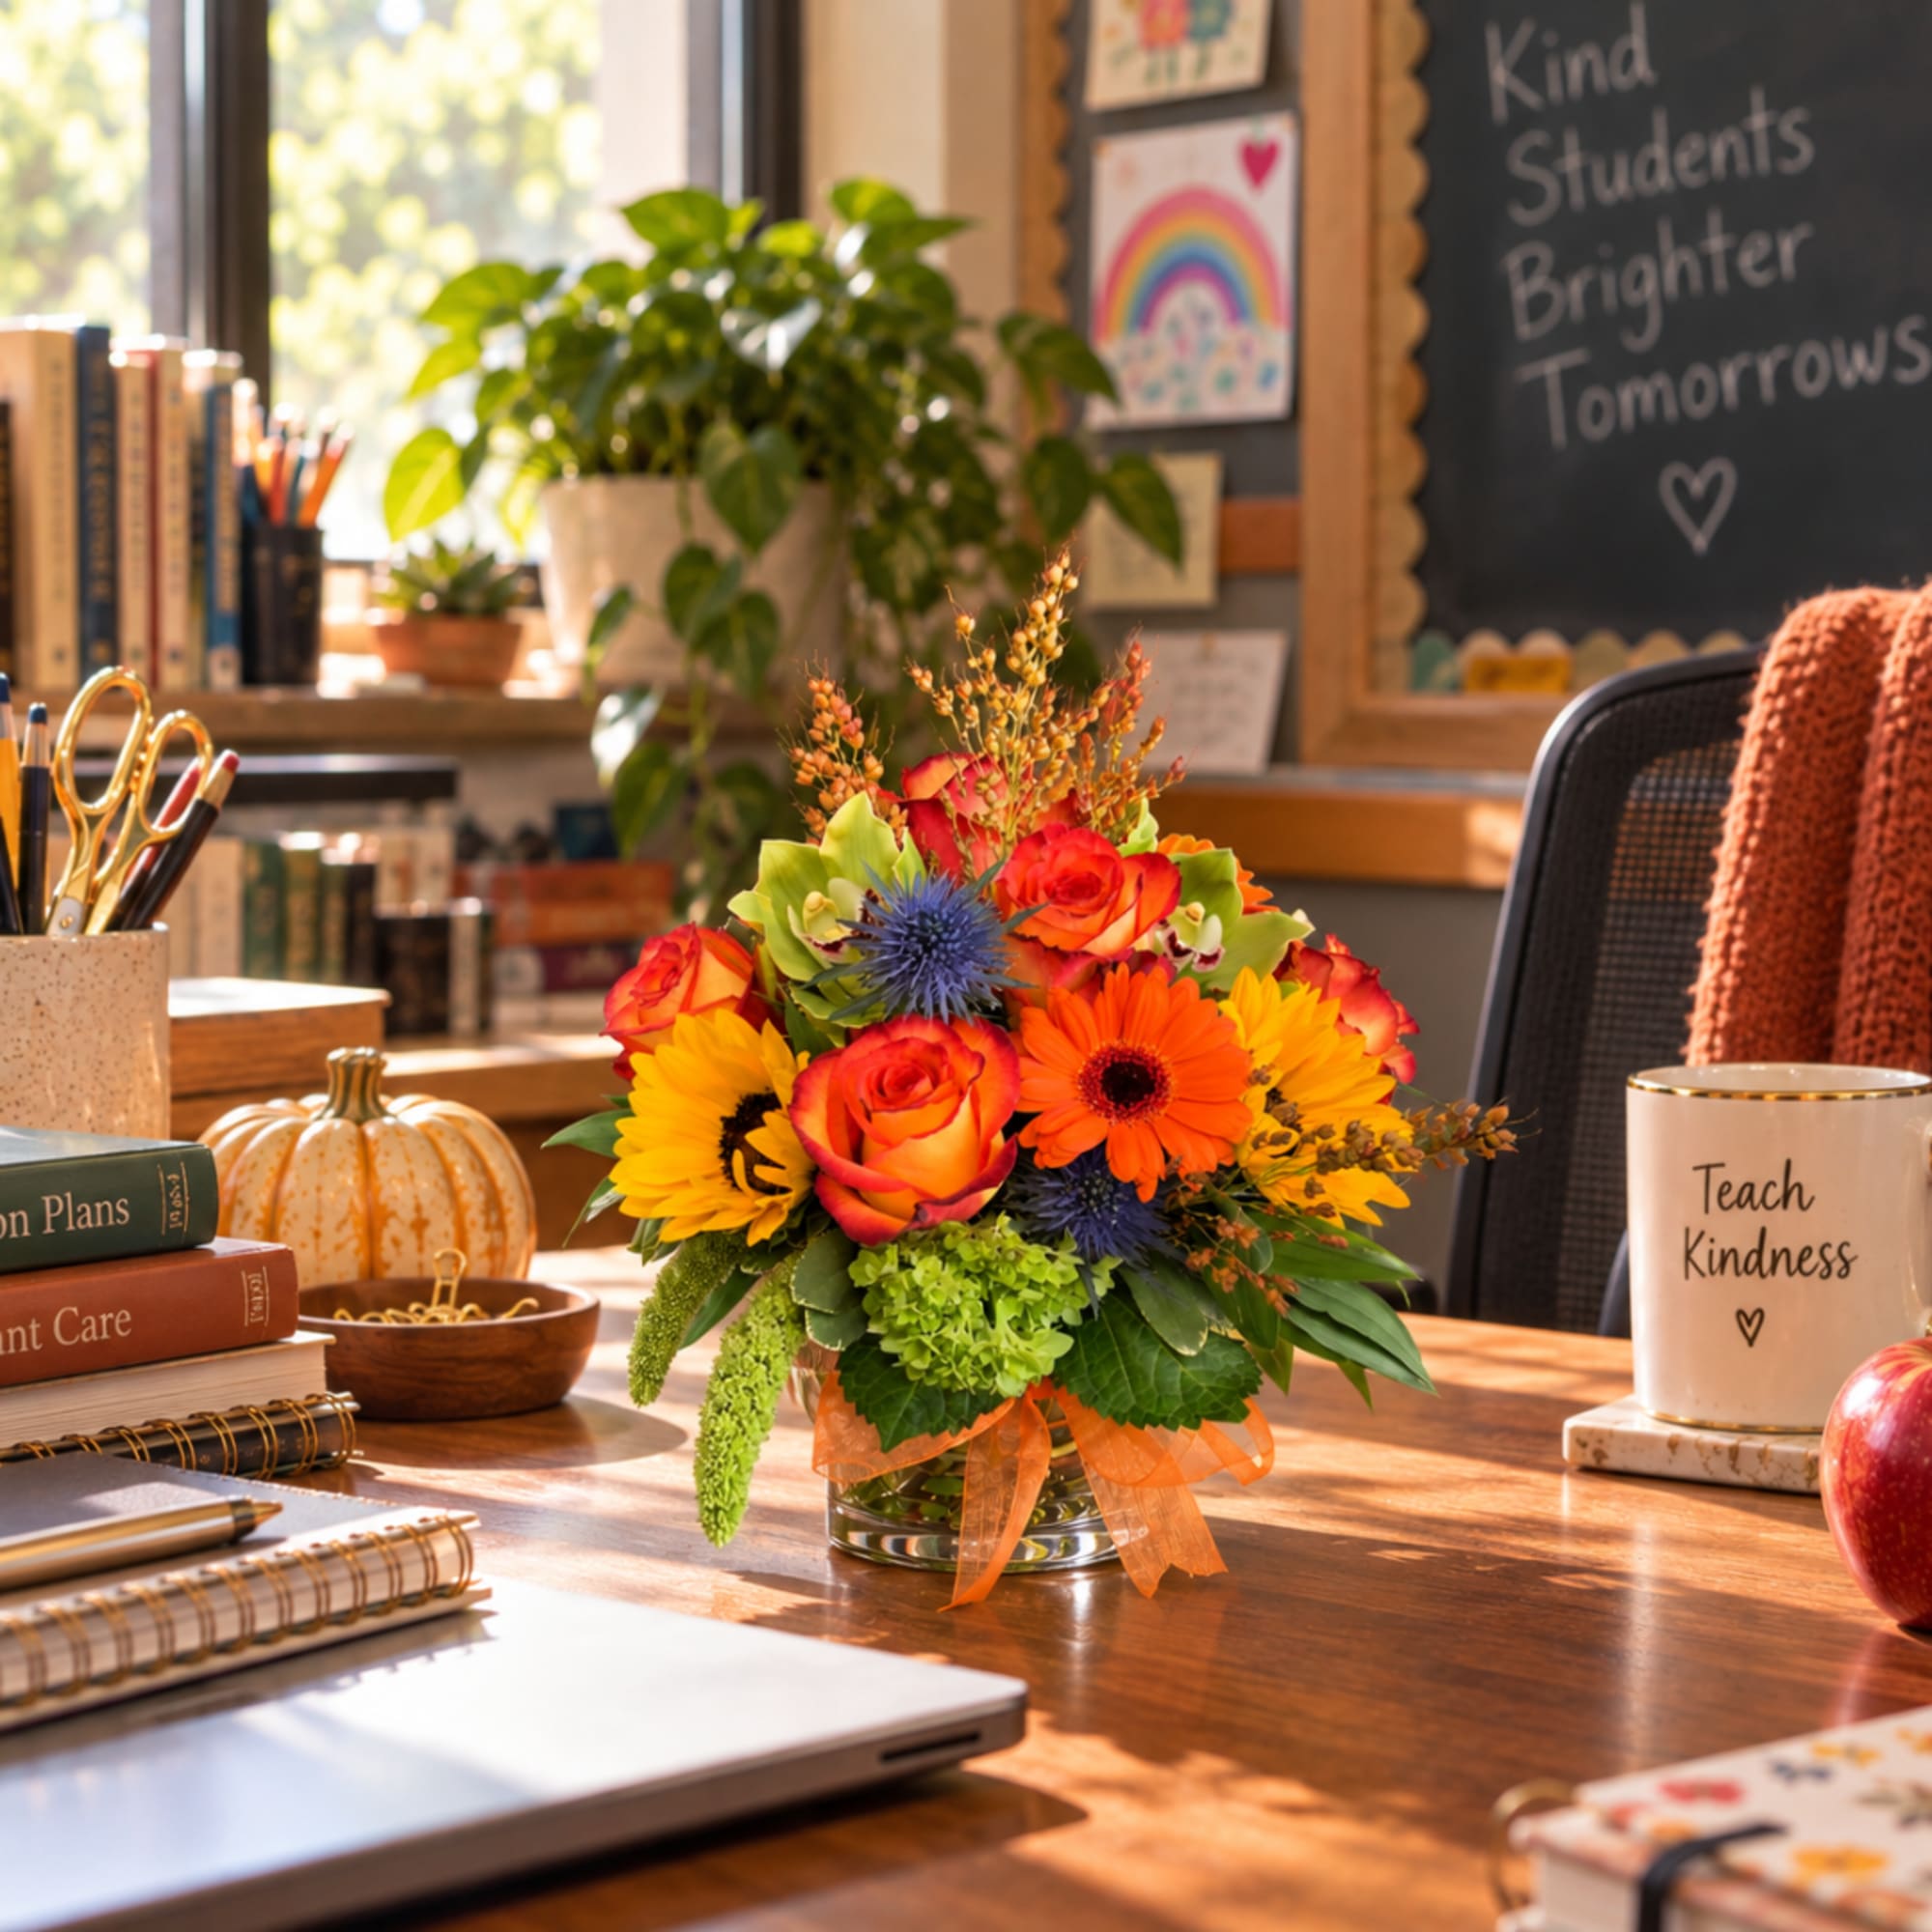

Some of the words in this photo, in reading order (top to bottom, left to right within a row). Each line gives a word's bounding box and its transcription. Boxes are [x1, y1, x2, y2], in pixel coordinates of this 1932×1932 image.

[1485, 0, 1658, 125] Kind
[1505, 85, 1815, 227] Students
[1502, 206, 1814, 354] Brighter
[1514, 313, 1932, 451] Tomorrows
[41, 1191, 130, 1235] Plans
[1692, 1158, 1815, 1214] Teach
[1684, 1226, 1859, 1281] Kindness
[0, 1318, 43, 1355] nt
[53, 1305, 132, 1347] Care
